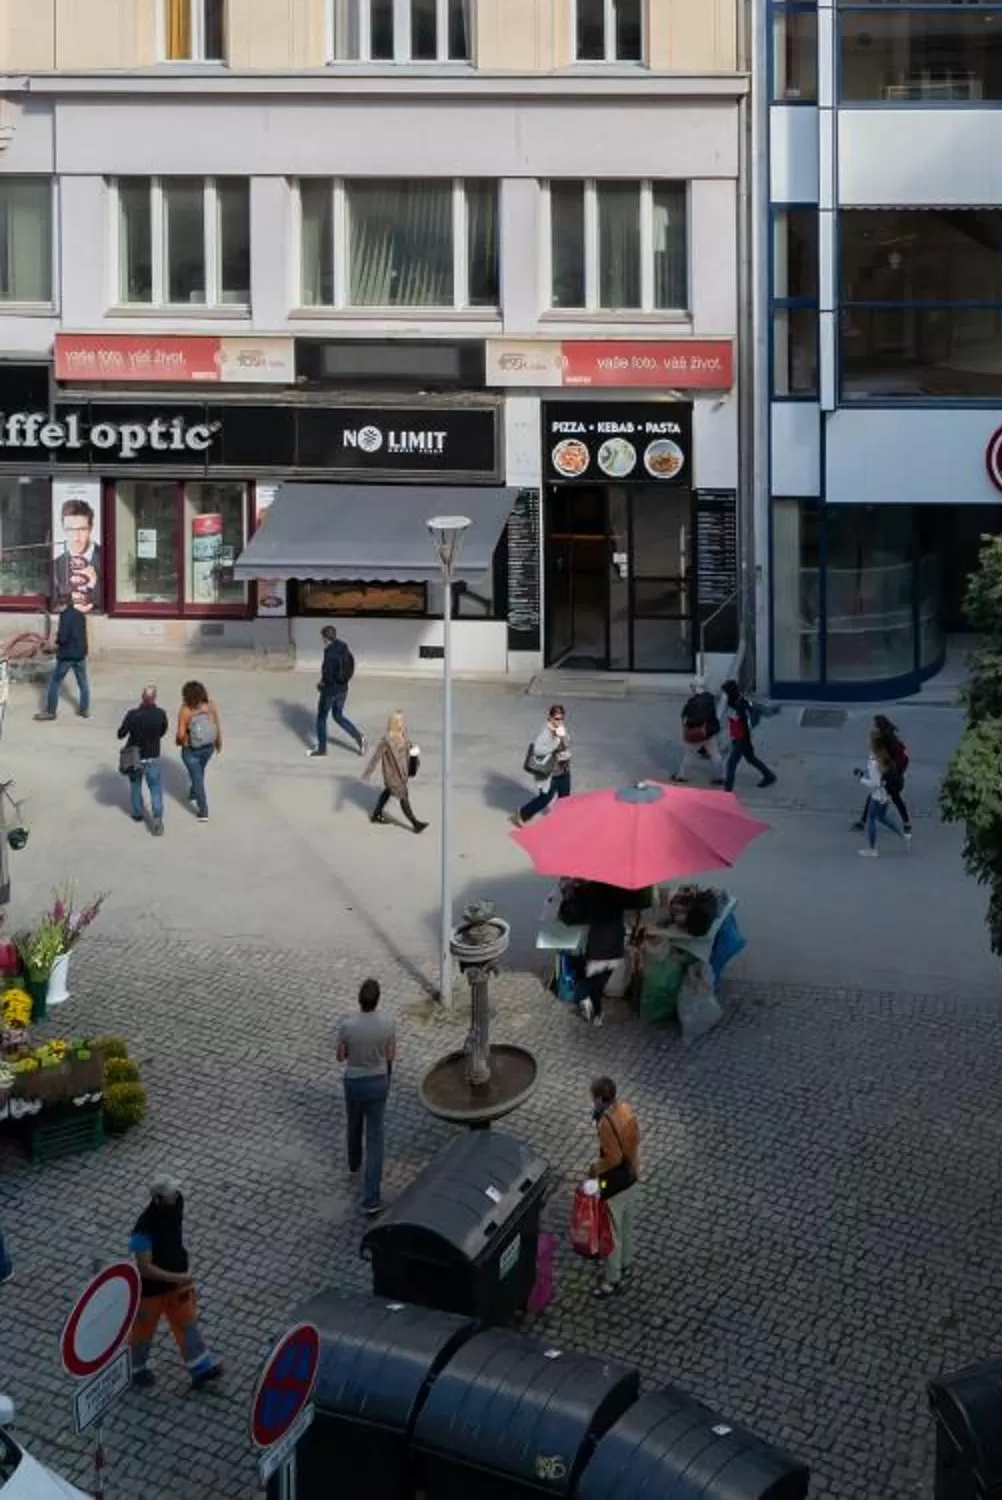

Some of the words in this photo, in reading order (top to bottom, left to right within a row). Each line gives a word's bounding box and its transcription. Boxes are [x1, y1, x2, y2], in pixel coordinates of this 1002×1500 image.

[0, 412, 81, 448] ffel
[90, 416, 212, 458] optic
[552, 421, 587, 433] PIZZA
[597, 421, 635, 433] KEBAB
[645, 421, 681, 433] PASTA
[387, 430, 447, 450] LIMIT
